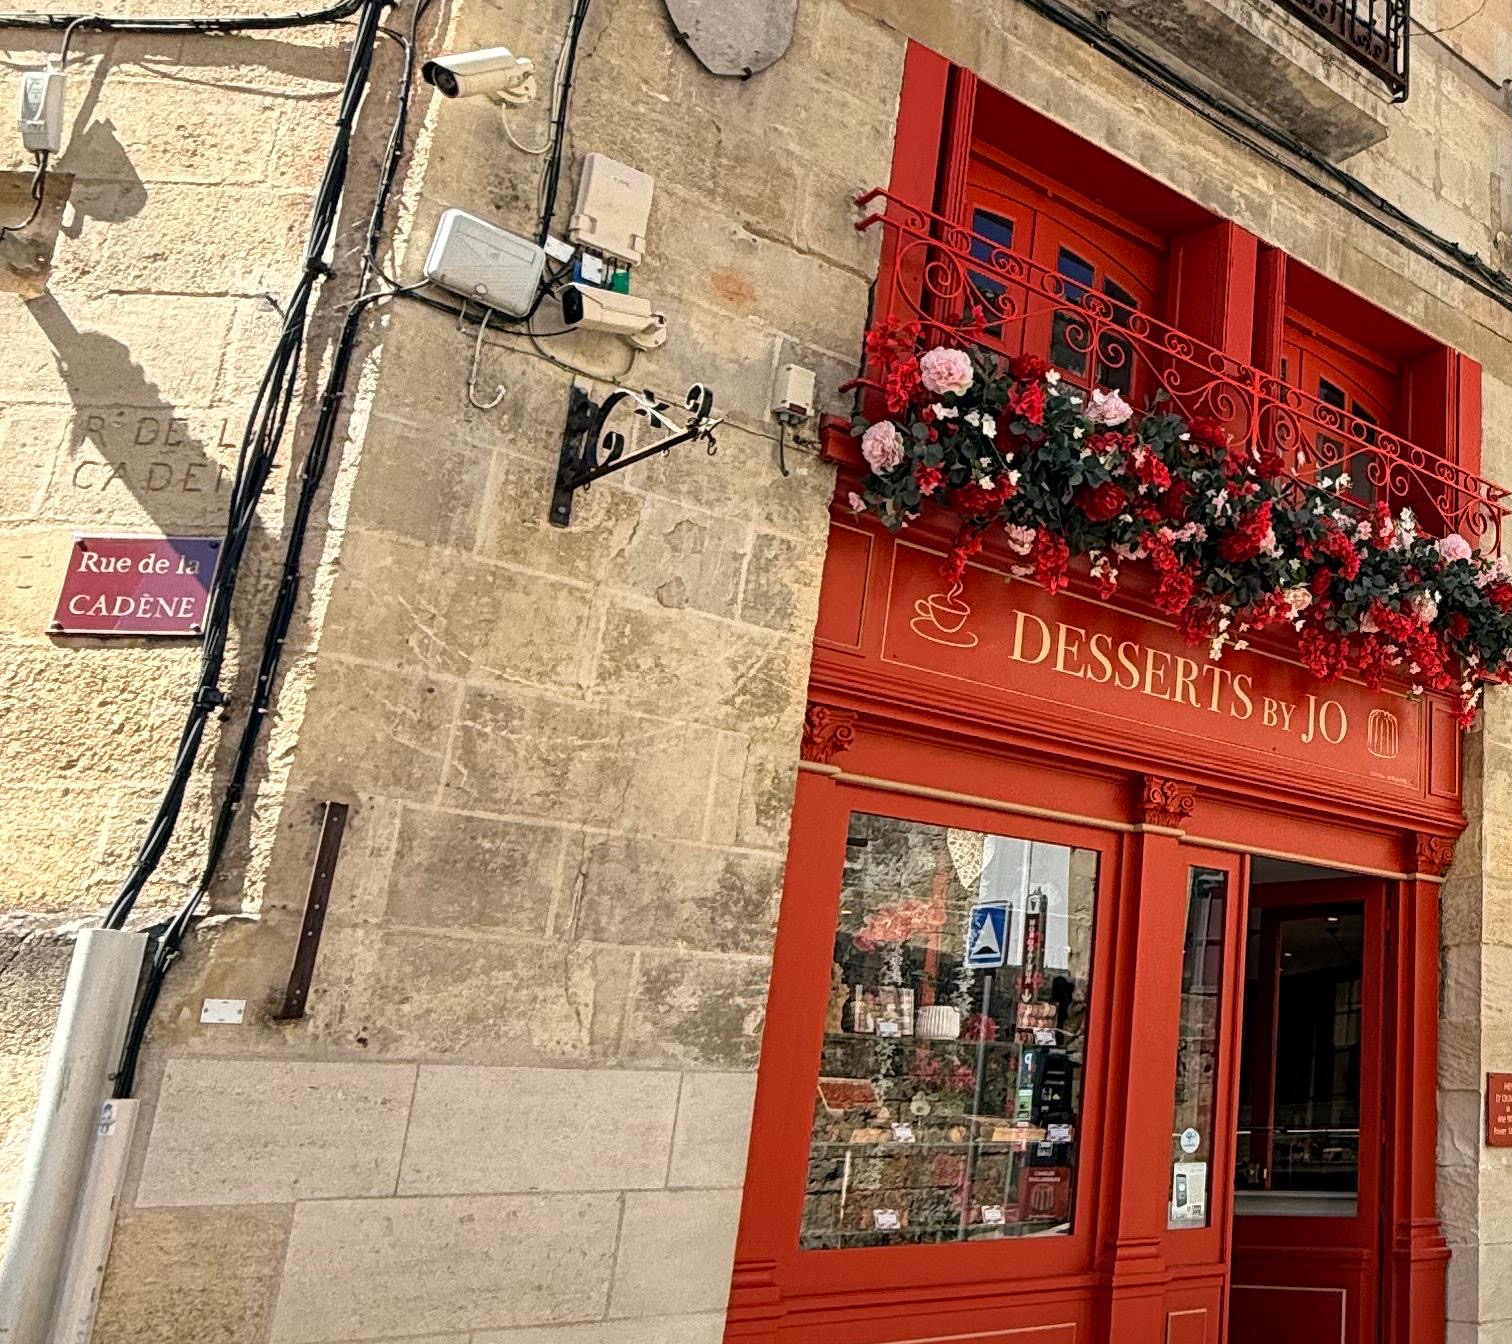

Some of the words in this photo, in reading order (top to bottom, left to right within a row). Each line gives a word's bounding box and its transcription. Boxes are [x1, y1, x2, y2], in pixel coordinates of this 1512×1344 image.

[77, 552, 131, 574] Rue
[138, 553, 170, 575] de
[176, 555, 200, 575] la
[68, 593, 195, 618] CADÈNE
[1008, 609, 1255, 720] DESSERTS
[1262, 696, 1297, 732] BY
[1301, 694, 1348, 745] JO
